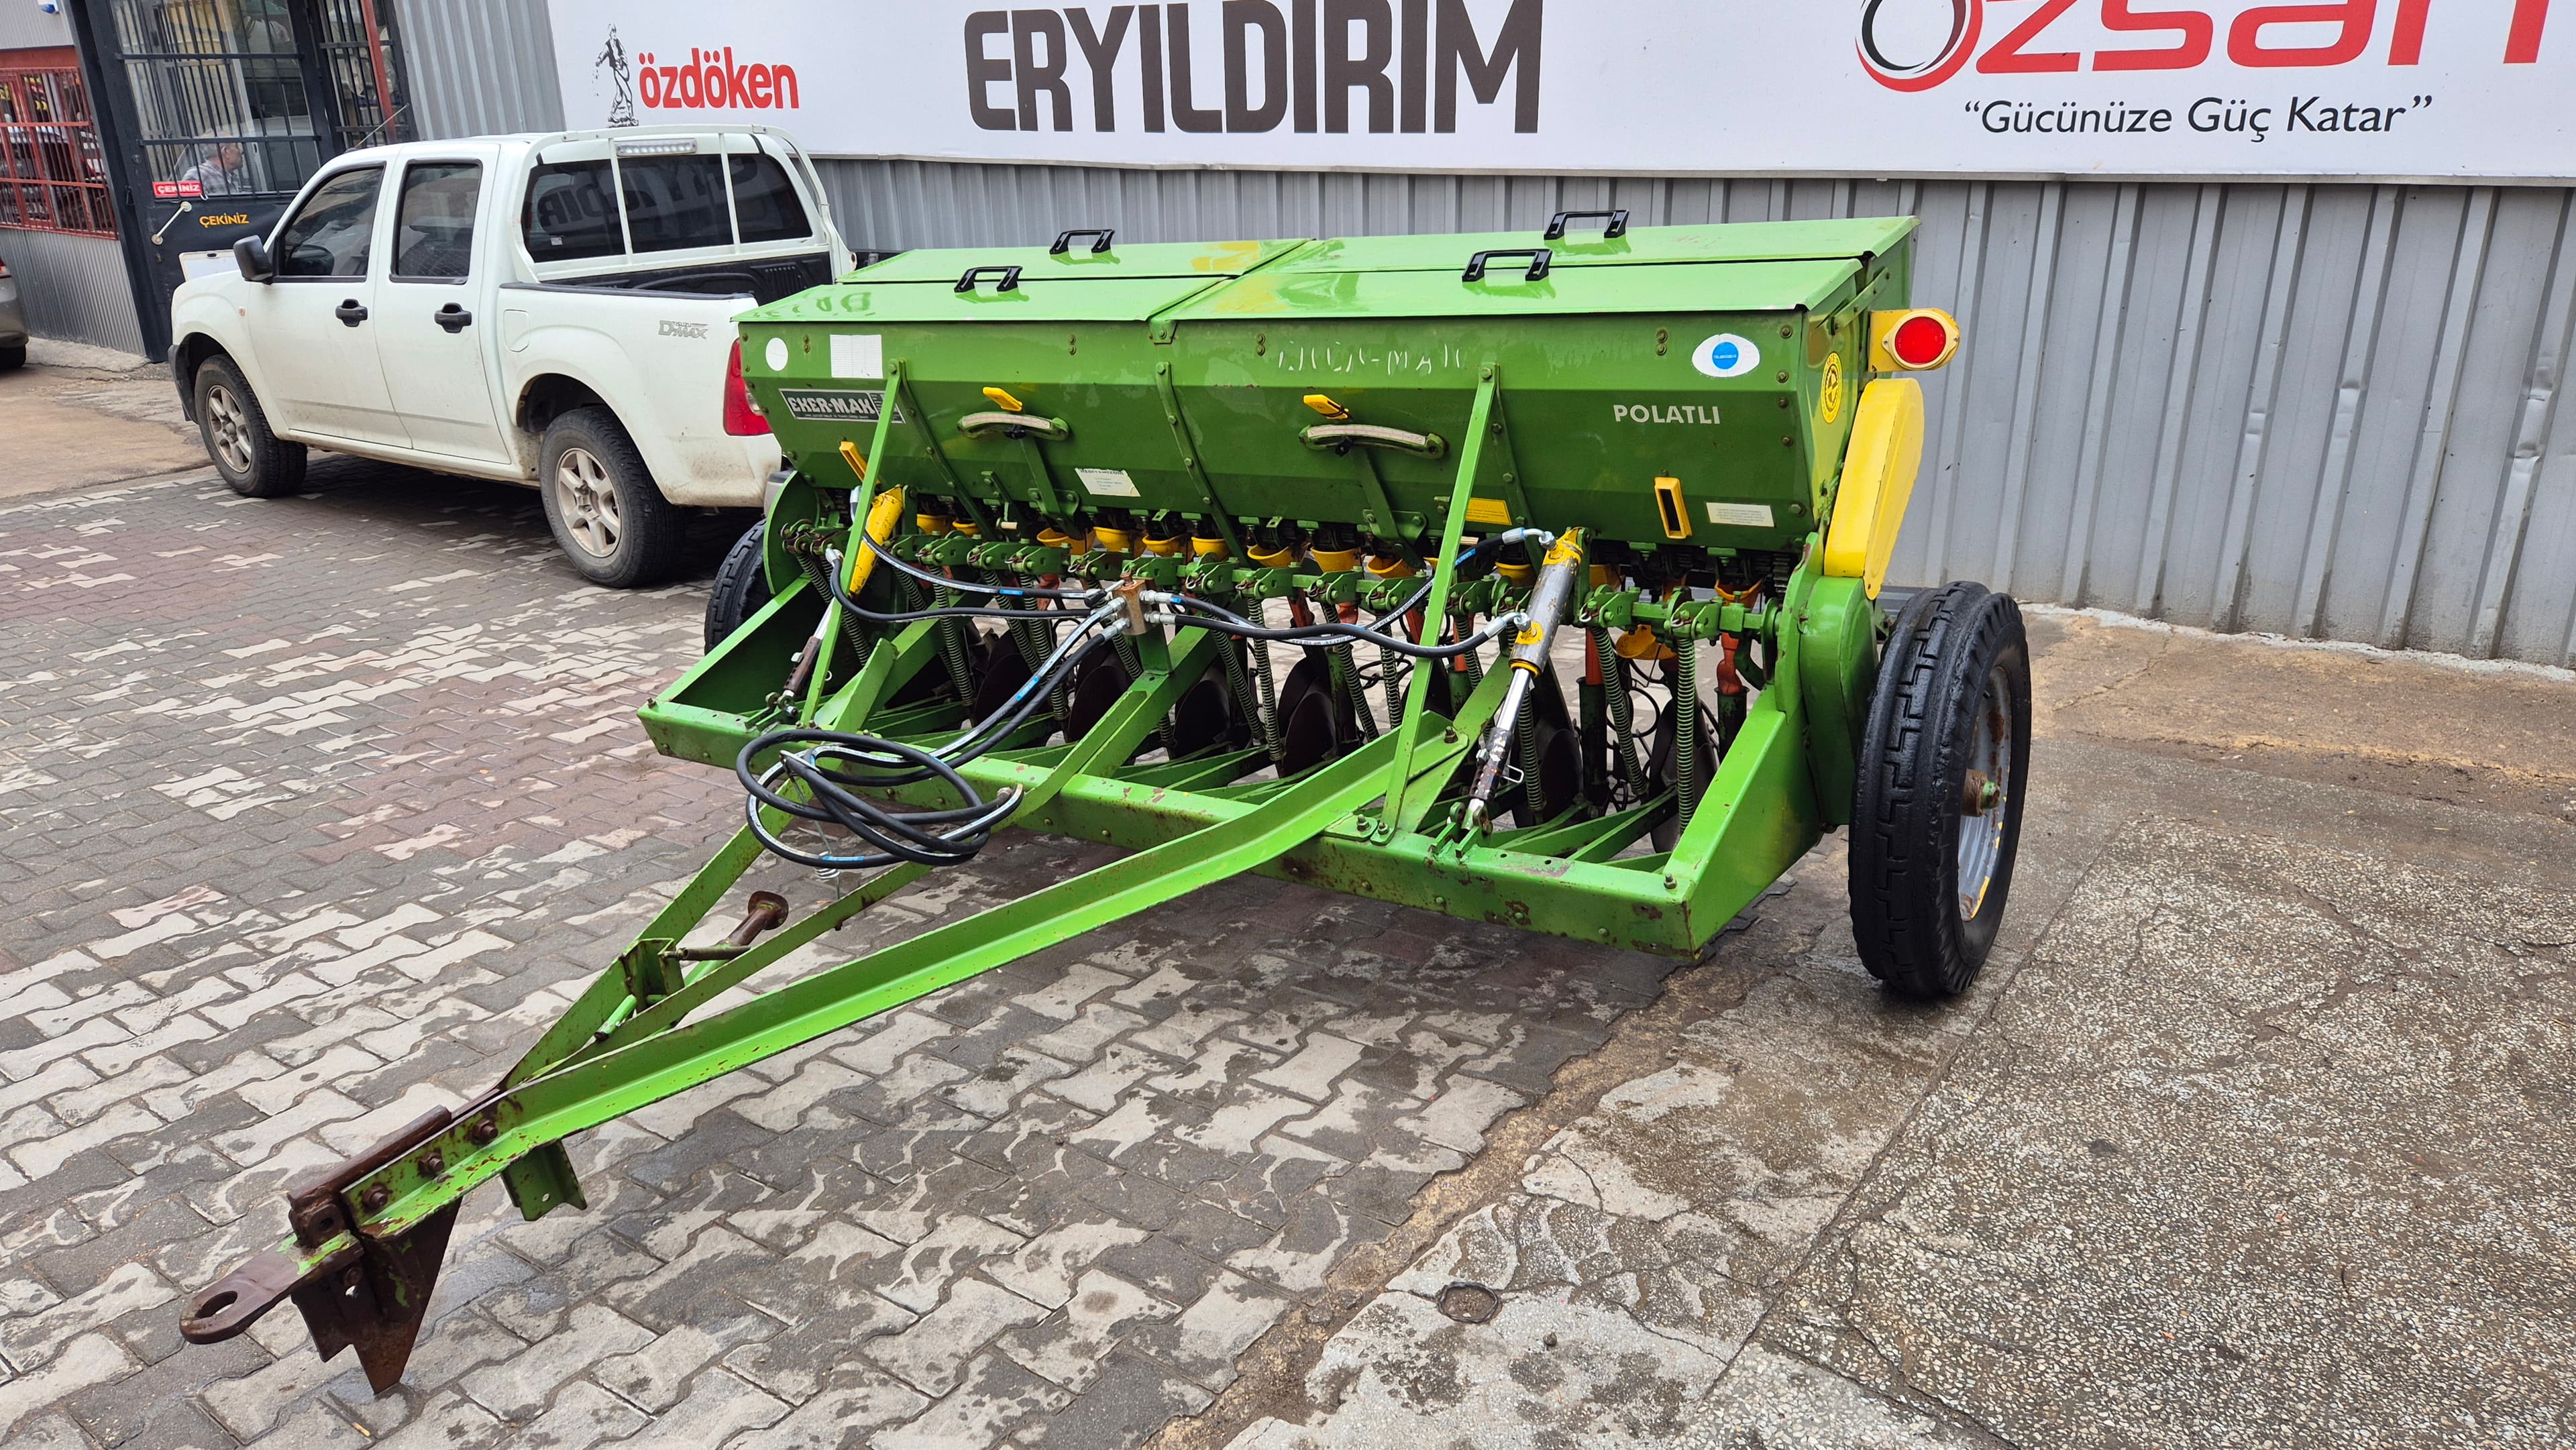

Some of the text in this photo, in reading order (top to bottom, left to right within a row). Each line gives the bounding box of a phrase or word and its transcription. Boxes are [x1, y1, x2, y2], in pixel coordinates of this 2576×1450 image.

[639, 46, 800, 109] özdöken
[964, 0, 1544, 133] ERYILDIRIM
[2188, 96, 2271, 143] Güç
[199, 212, 250, 228] ÇEKİNİZ
[1613, 404, 1721, 425] POLATLI
